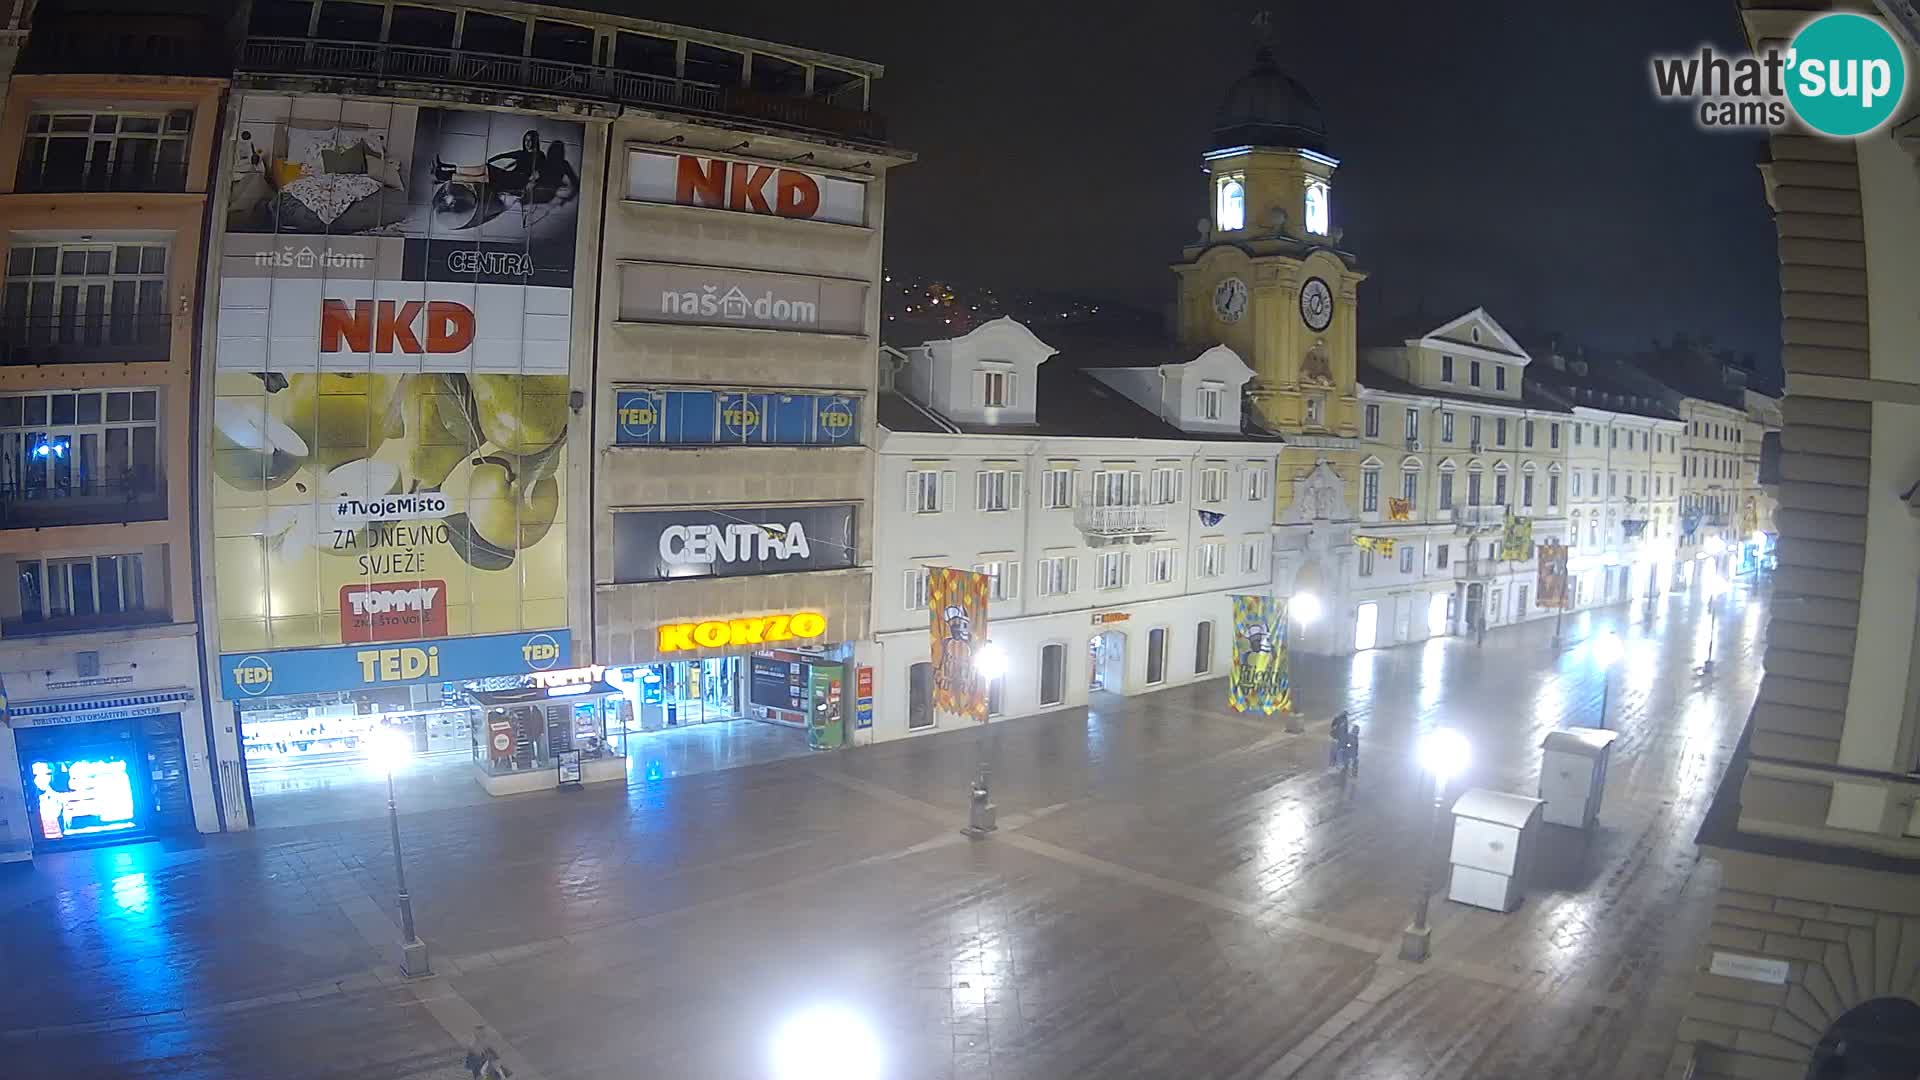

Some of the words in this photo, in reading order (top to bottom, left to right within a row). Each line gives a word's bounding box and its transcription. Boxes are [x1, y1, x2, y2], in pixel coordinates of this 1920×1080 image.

[675, 154, 820, 218] NKD
[255, 246, 293, 268] naš
[319, 248, 365, 269] dom
[447, 250, 535, 276] CENTRA
[661, 284, 718, 317] naš
[753, 290, 816, 322] dom
[319, 298, 477, 354] NKD
[619, 409, 657, 425] TEDi
[723, 410, 760, 426] TEDi
[820, 411, 852, 427] TEDi
[337, 497, 446, 516] #TvojeMisto
[333, 529, 357, 550] ZA
[366, 524, 450, 549] DNEVNO
[659, 522, 810, 564] CENTRA
[359, 548, 426, 576] SVJEŽE
[348, 587, 439, 615] TOMMY
[658, 612, 826, 652] KORZO
[357, 646, 439, 683] TEDi
[522, 644, 560, 661] TEDi
[233, 666, 273, 685] TEDi
